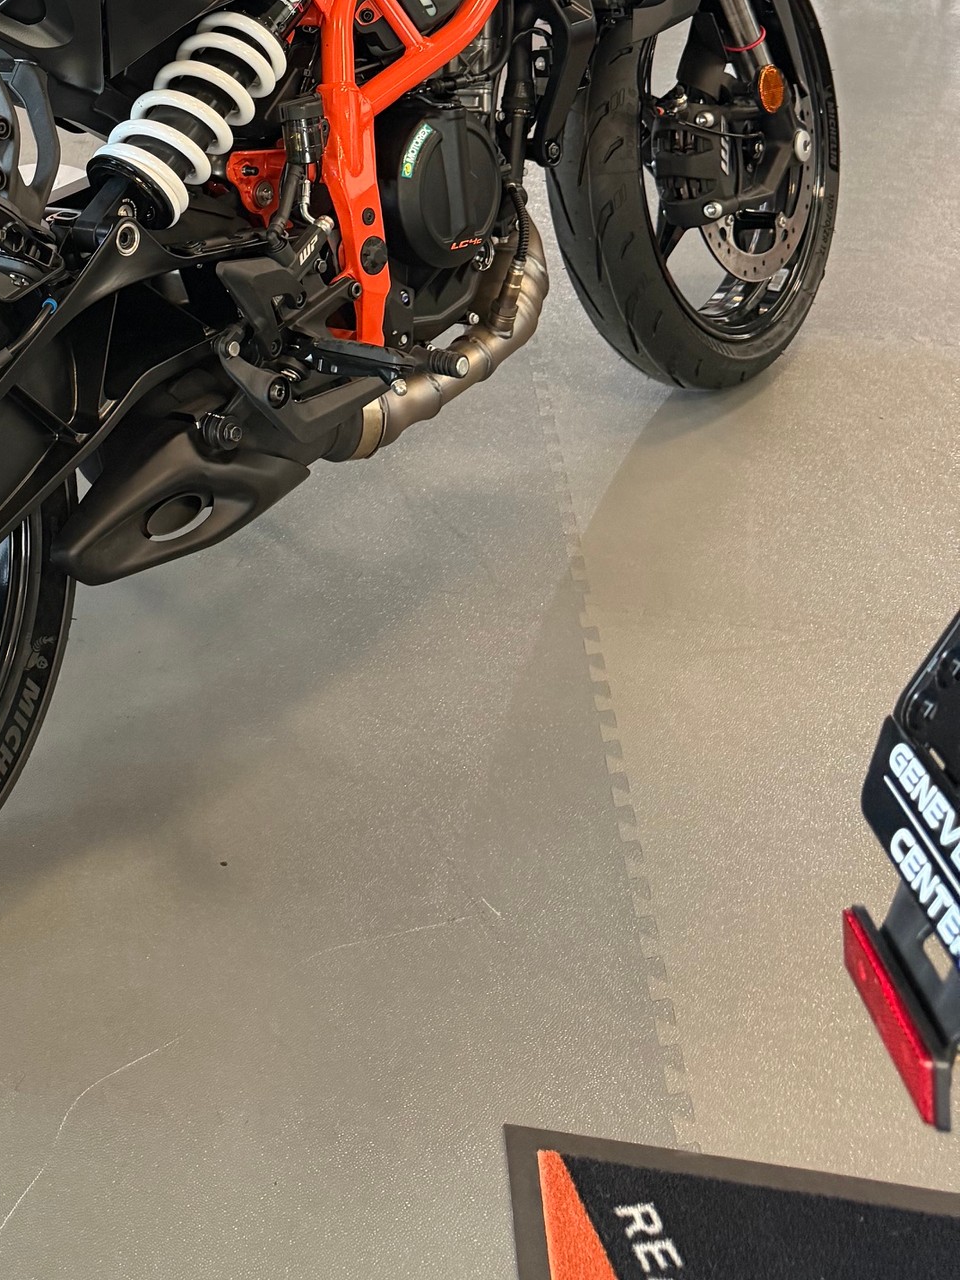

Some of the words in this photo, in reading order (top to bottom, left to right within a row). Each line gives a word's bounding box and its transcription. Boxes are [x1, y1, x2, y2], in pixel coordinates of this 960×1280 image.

[407, 123, 432, 164] MOTOREX
[827, 100, 838, 166] MICHELIN
[299, 234, 318, 266] WP
[613, 1201, 683, 1280] RE
